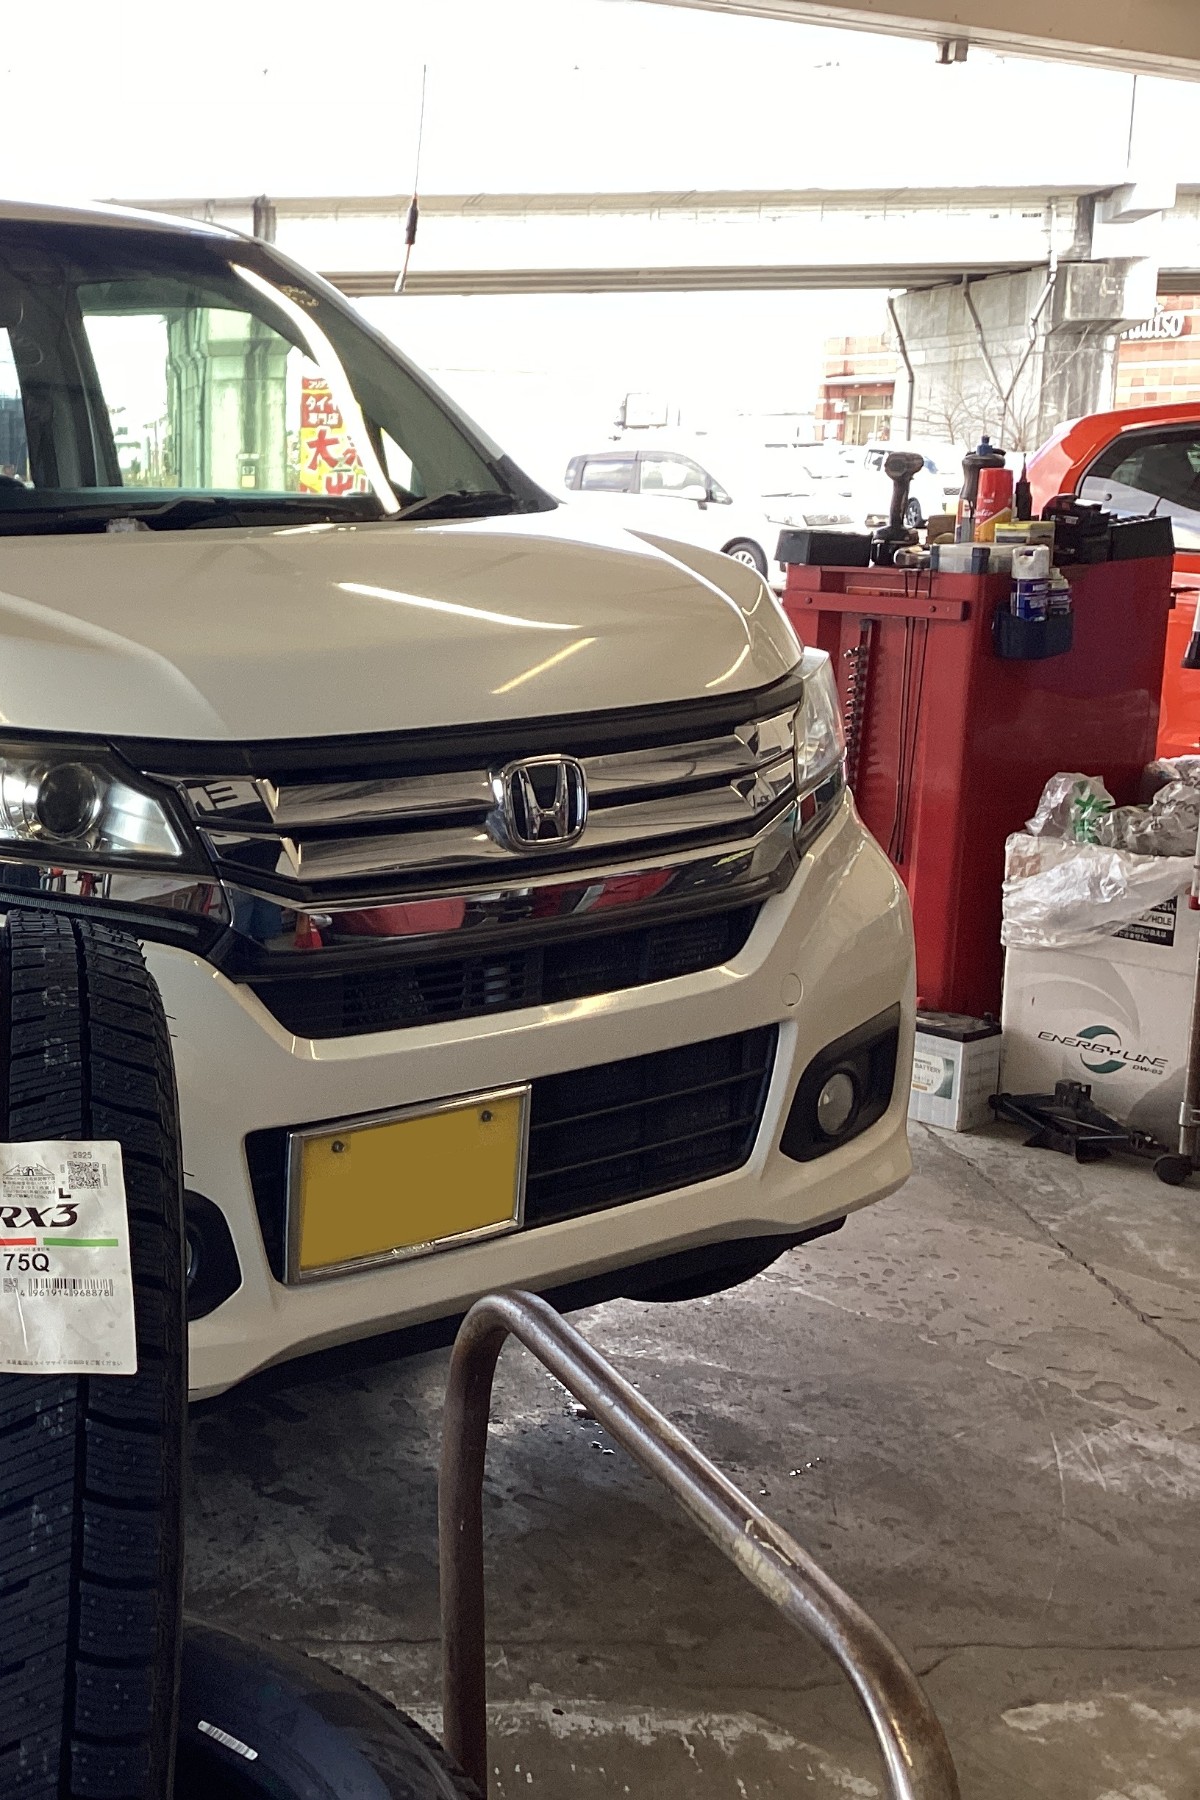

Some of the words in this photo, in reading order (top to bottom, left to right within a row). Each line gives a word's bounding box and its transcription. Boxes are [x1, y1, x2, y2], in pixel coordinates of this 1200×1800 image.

[1038, 1031, 1121, 1055] ENERGY
[58, 1188, 71, 1199] L
[3, 1253, 50, 1273] 75Q
